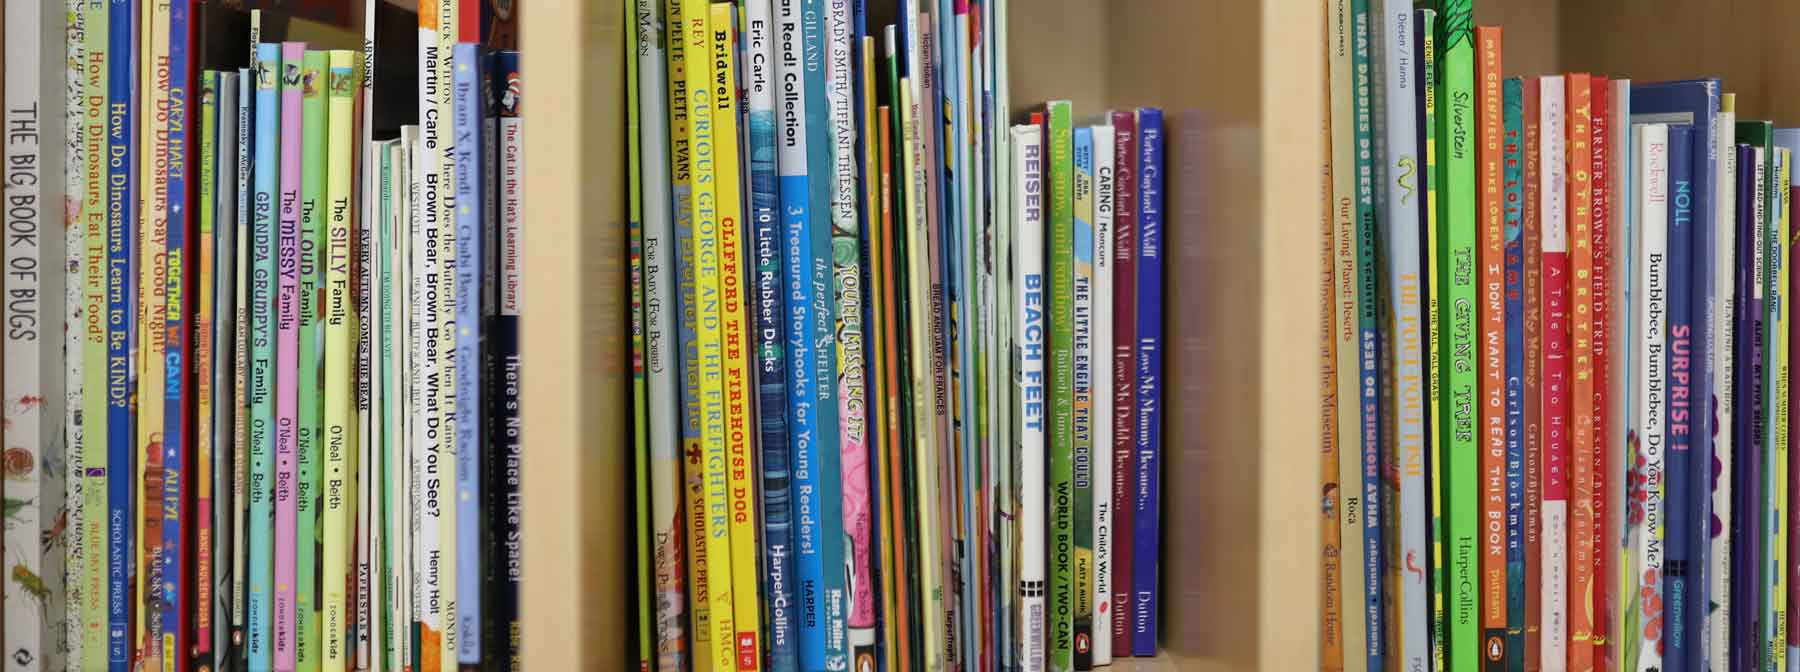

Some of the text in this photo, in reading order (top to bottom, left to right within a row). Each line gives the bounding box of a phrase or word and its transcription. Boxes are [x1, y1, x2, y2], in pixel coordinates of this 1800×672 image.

[672, 21, 689, 180] PEETE PEETE EVANS
[833, 1, 852, 219] BRADY SMITH/TIFFANI THIESSEN
[1357, 13, 1371, 205] WHAT DADDIES DO BEST
[1398, 13, 1409, 89] Diesen Hanna
[1425, 40, 1433, 71] DENISE
[1426, 73, 1434, 108] FLEMING
[10, 102, 37, 340] THE BIG BOOK OF BUGS
[90, 52, 103, 343] How Do Dinosaurs Eat Their Food?
[360, 39, 372, 411] ARNOSKY EVERY AUTUMN COMES THE BEAR
[504, 124, 517, 310] The Cat in the Hat's Learning Library
[692, 18, 727, 538] REY CURIOUS GEORGE AND THE FIREFIGHTERS
[805, 11, 833, 400] GILLAND the perfect SHELTER
[1675, 180, 1690, 226] NOLL
[424, 46, 440, 614] Martin Carle Brown Bear, Brown Bear, What Do You See? Henry Holt
[752, 20, 787, 646] Eric Carle 10 Little Rubber Ducks HarperCollins
[782, 22, 816, 628] Read! Collection 3 Treasured Storybooks for Young Readers! HARPER
[933, 315, 942, 335] AND
[935, 356, 944, 373] FOR
[1025, 145, 1042, 433] REISER BEACH FEET
[1076, 277, 1088, 301] THE
[1076, 307, 1088, 350] LITTLE
[1339, 197, 1358, 524] Our Living Planet: Deserts Roca
[1452, 91, 1472, 625] Silverstein THE GIVING TREE HarperCollins
[1487, 73, 1503, 620] GREENFIELD MIKE LOWERY I DON'T WANT TO READ THIS BOOK putnam
[1646, 143, 1664, 569] Rockwell Bumblebee, Bumblebee, Do You Know Me?
[936, 375, 945, 417] FRANCES
[1076, 355, 1088, 402] ENGINE
[1076, 407, 1088, 441] THAT
[1098, 167, 1111, 593] CARING Moncure The Child's World
[1363, 331, 1377, 528] WHAT MOMMIES DO BEST
[1671, 325, 1690, 436] SURPRISE
[1076, 447, 1088, 488] COULD
[113, 510, 122, 614] SCHOLASTIC PRESS
[152, 577, 161, 597] SKY
[1057, 481, 1069, 650] WORLD BOOK TWO-CAN
[1673, 580, 1683, 648] Greenwillow
